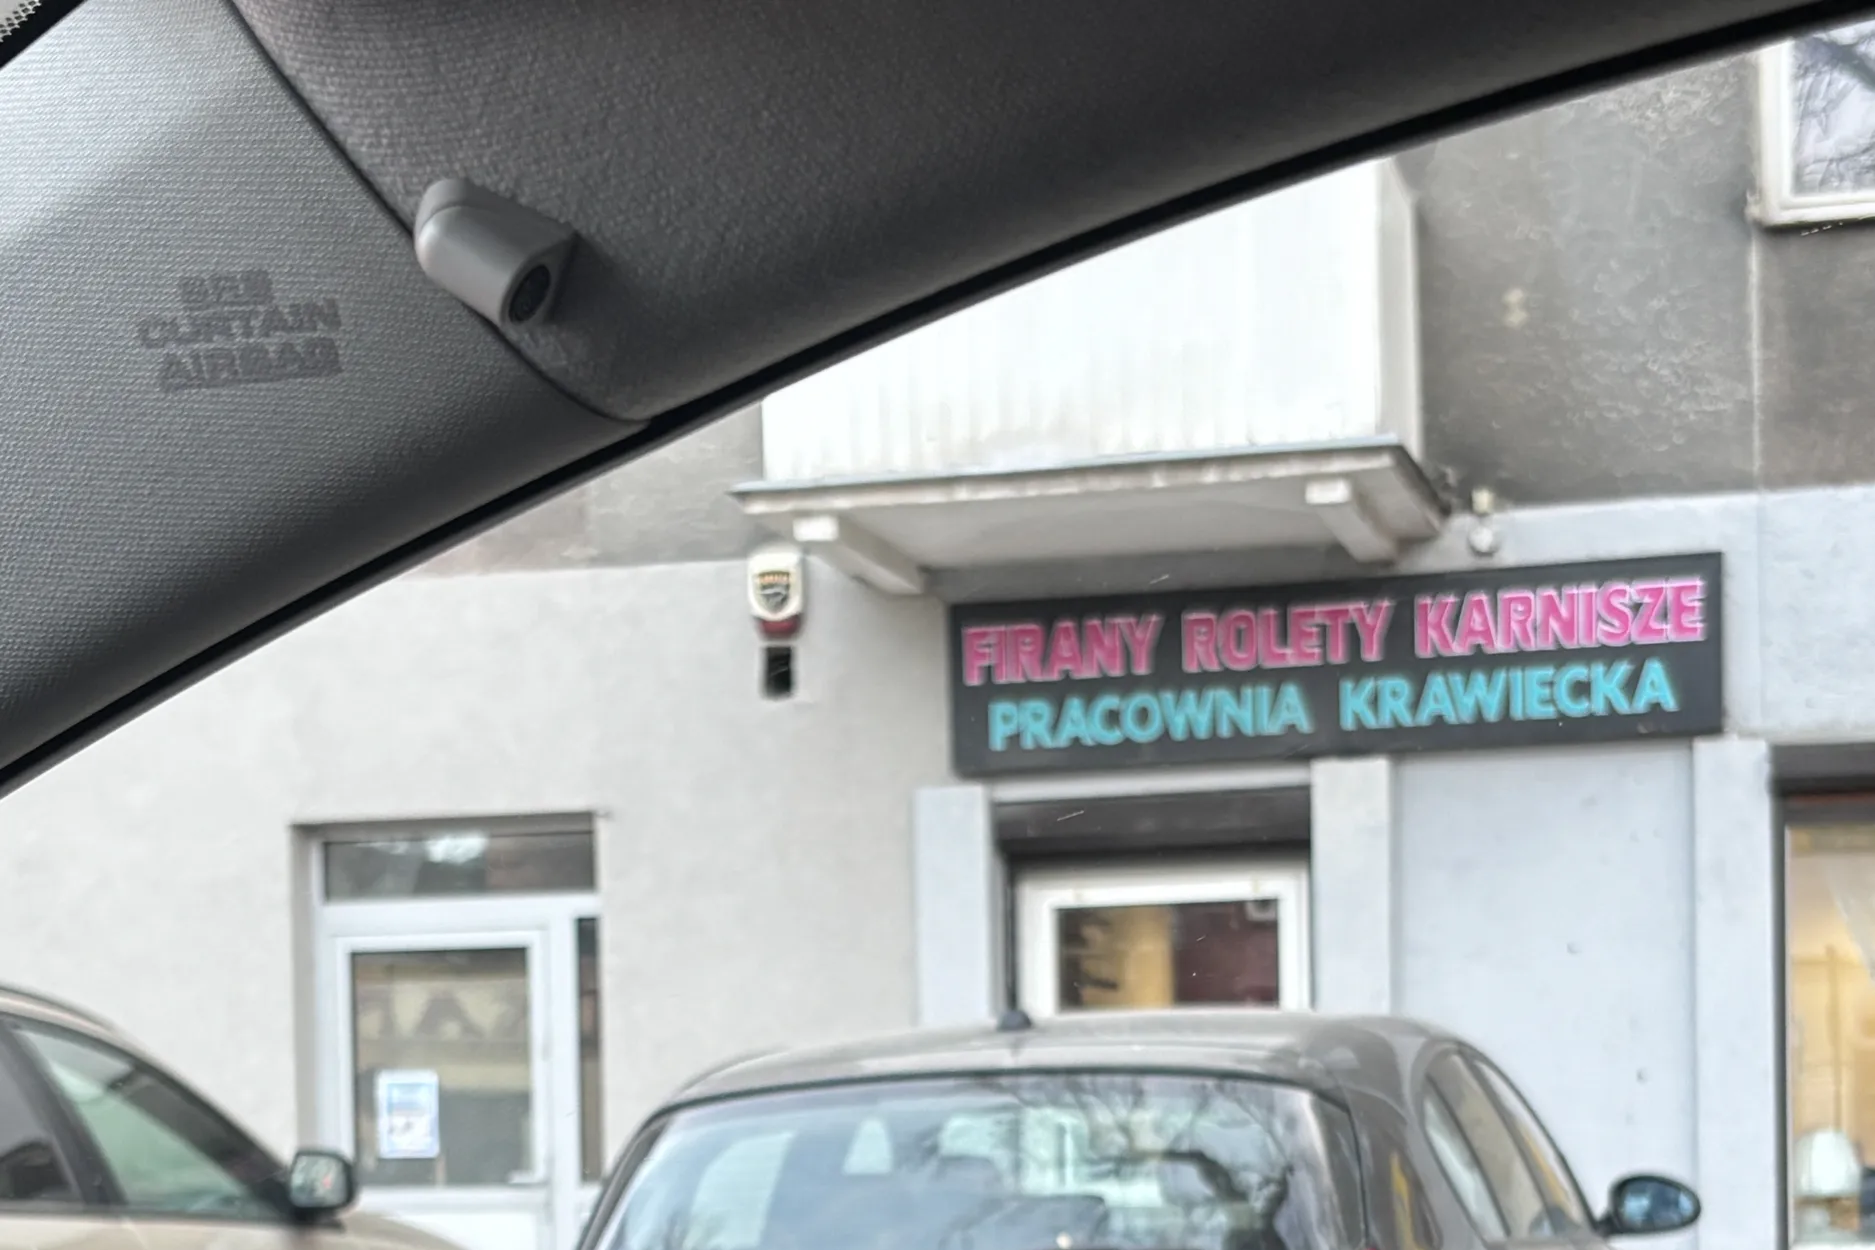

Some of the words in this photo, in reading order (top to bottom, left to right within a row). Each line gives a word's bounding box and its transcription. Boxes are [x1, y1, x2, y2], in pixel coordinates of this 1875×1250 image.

[964, 613, 1160, 685] FIRANY
[1183, 599, 1391, 672] ROLETY
[1416, 577, 1705, 658] KARNISZE
[988, 682, 1312, 750] PRACOWNIA
[1338, 656, 1680, 731] KRAWIECKA
